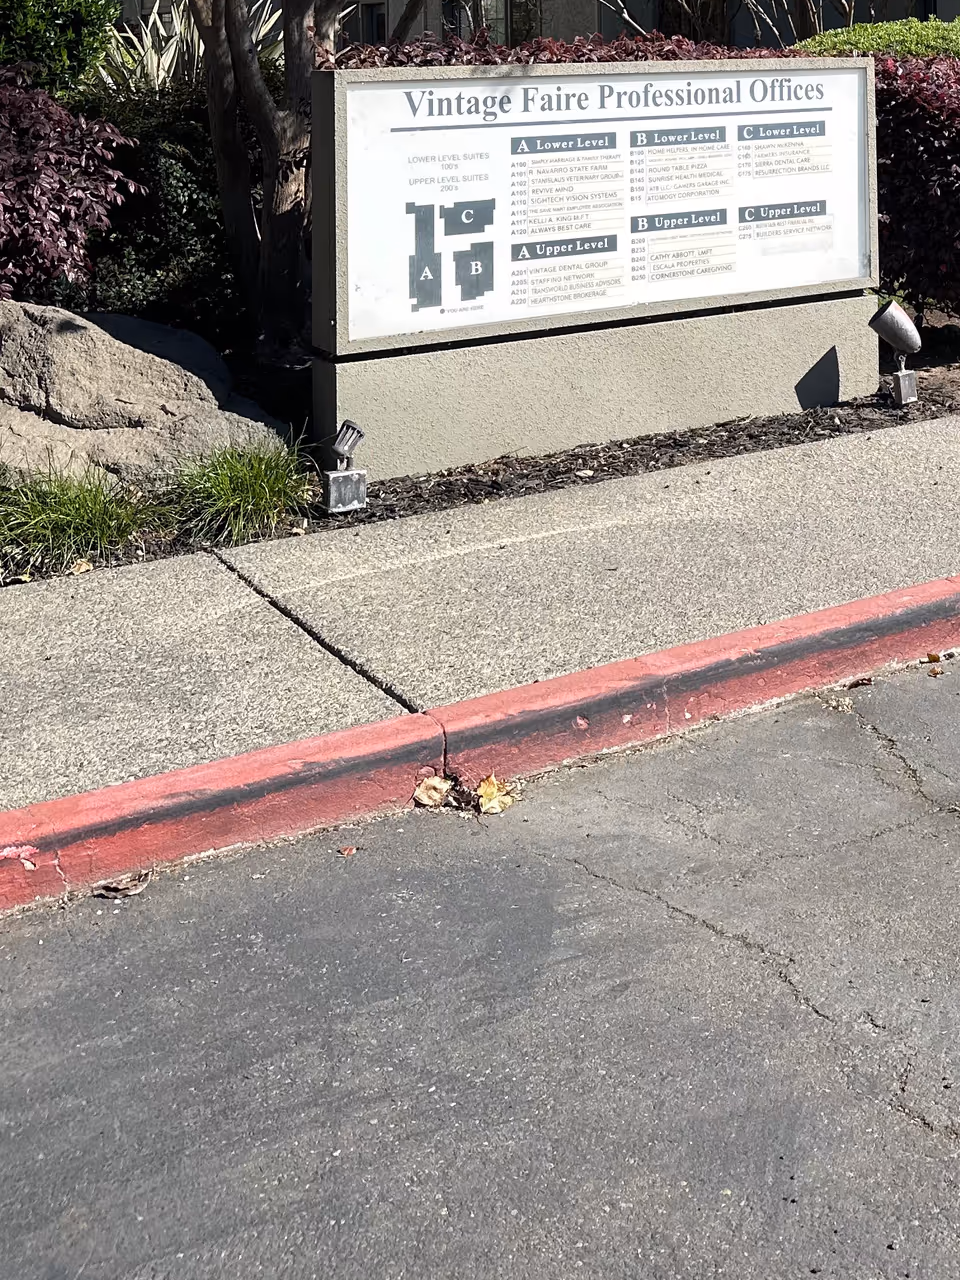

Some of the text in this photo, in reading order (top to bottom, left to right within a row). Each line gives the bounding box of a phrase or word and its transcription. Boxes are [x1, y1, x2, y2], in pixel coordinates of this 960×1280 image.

[404, 78, 824, 122] Vintage Faire Professional Offices
[636, 130, 720, 145] B Lower Level
[744, 124, 819, 139] C Lower Level
[517, 136, 608, 152] A Lower Level
[408, 155, 436, 163] LOWER
[755, 167, 796, 175] RESURRECTION
[648, 174, 673, 183] SUNRISE
[531, 196, 564, 204] SIGHTECH
[678, 190, 719, 198] CORPORATION
[461, 210, 474, 223] C
[745, 203, 820, 220] C Upper Level
[638, 212, 720, 230] B Upper Level
[518, 238, 608, 258] A Upper Level
[470, 261, 482, 275] B
[677, 259, 709, 267] PROPERTIES
[420, 266, 433, 280] A
[651, 270, 694, 280] CORNERSTONE
[696, 265, 732, 274] CAREGIVING
[531, 295, 572, 304] HEARTHSTONE
[573, 290, 606, 298] BROKERAGE
[532, 285, 568, 295] TRANSWORLD
